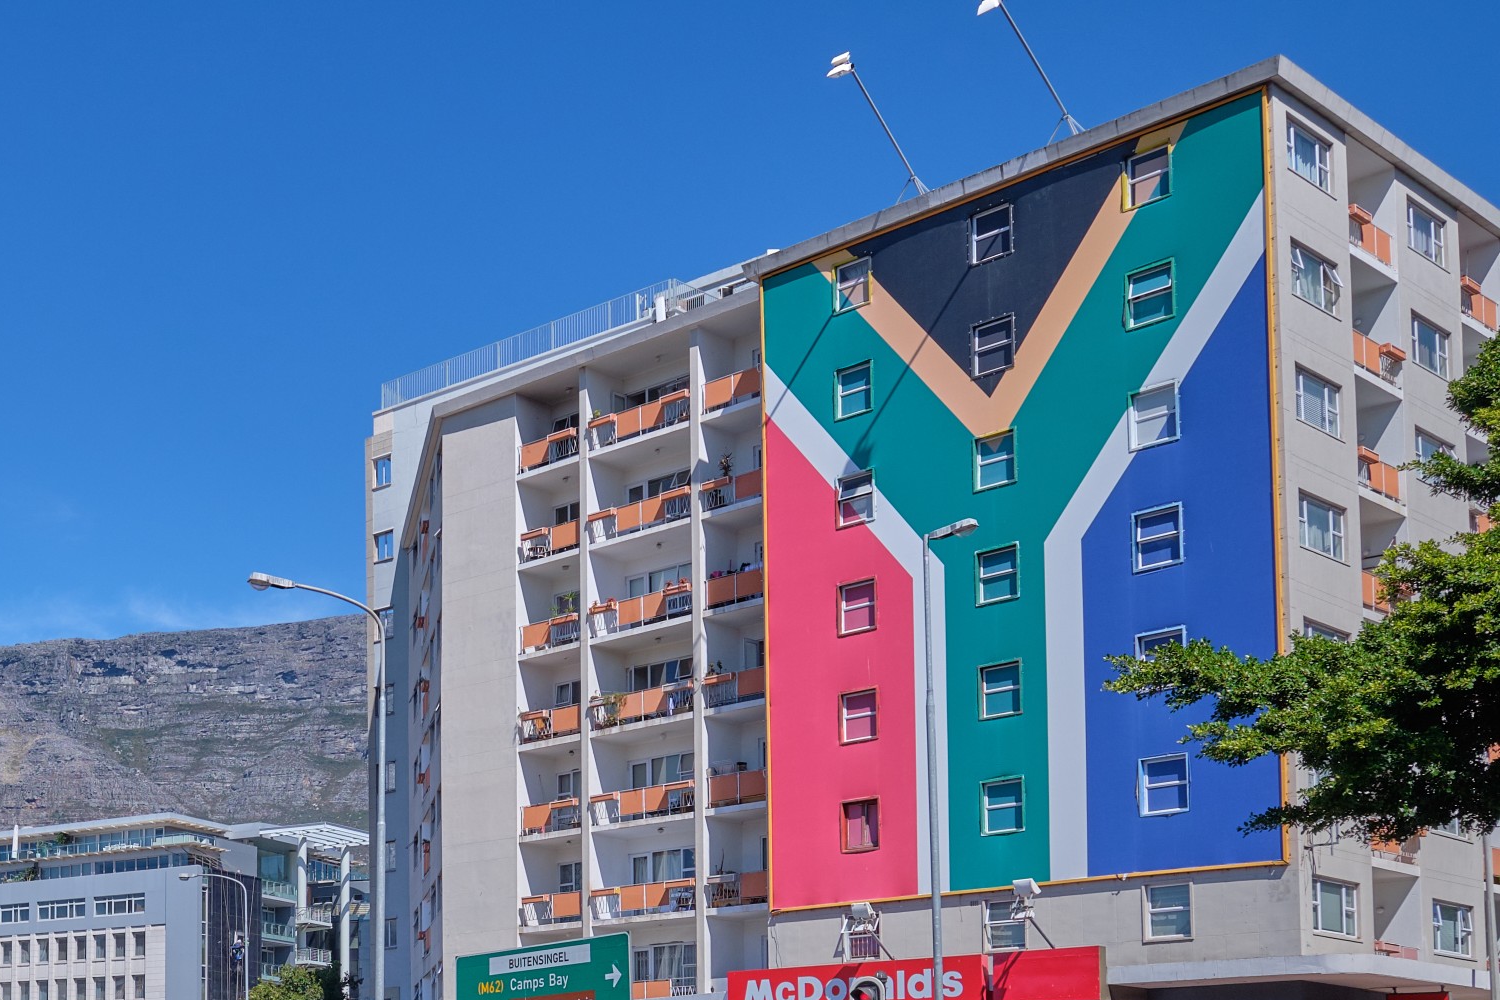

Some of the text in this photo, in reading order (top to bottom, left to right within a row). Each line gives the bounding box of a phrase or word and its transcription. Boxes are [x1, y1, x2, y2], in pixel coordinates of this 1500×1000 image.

[509, 952, 569, 969] BUITENSINGEL
[478, 973, 569, 995] (M62) Camps Bay
